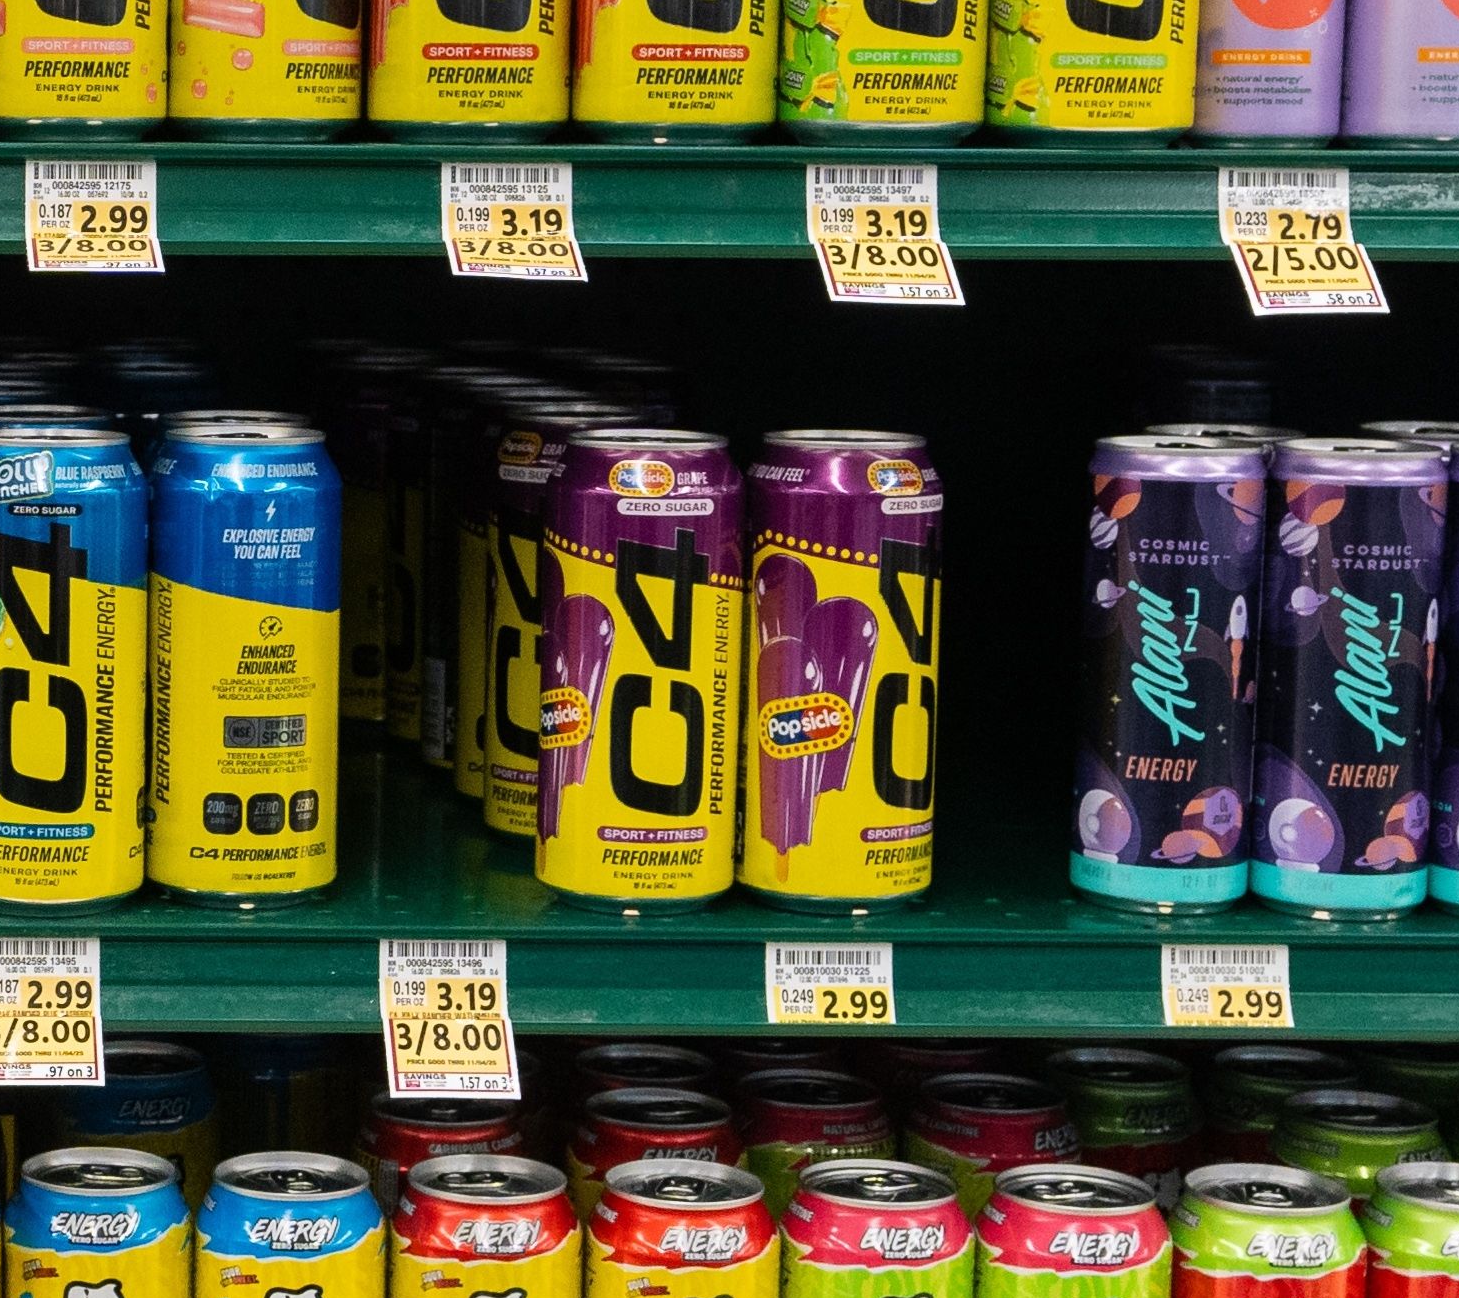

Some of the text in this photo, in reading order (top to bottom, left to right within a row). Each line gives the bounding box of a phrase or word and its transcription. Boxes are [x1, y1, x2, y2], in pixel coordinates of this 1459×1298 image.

[105, 181, 131, 190] 12175
[81, 206, 148, 233] 2.99
[502, 209, 564, 235] 3.19
[1278, 213, 1342, 239] 2.79
[1244, 245, 1360, 273] 2/5.00
[1140, 539, 1211, 552] COSMIC
[1128, 552, 1222, 566] STARDUST
[240, 644, 295, 659] ENHANCED
[236, 660, 297, 675] ENDURANCE
[767, 704, 845, 740] Popsicle
[261, 730, 304, 745] SPORT
[1126, 756, 1197, 782] ENERGY
[393, 981, 496, 1011] 0.199 3.19
[396, 998, 412, 1006] PER
[1176, 988, 1283, 1020] 0.249 2.99
[459, 1076, 480, 1089] 1.57
[484, 1079, 499, 1089] on
[51, 1209, 139, 1241] ENERGY
